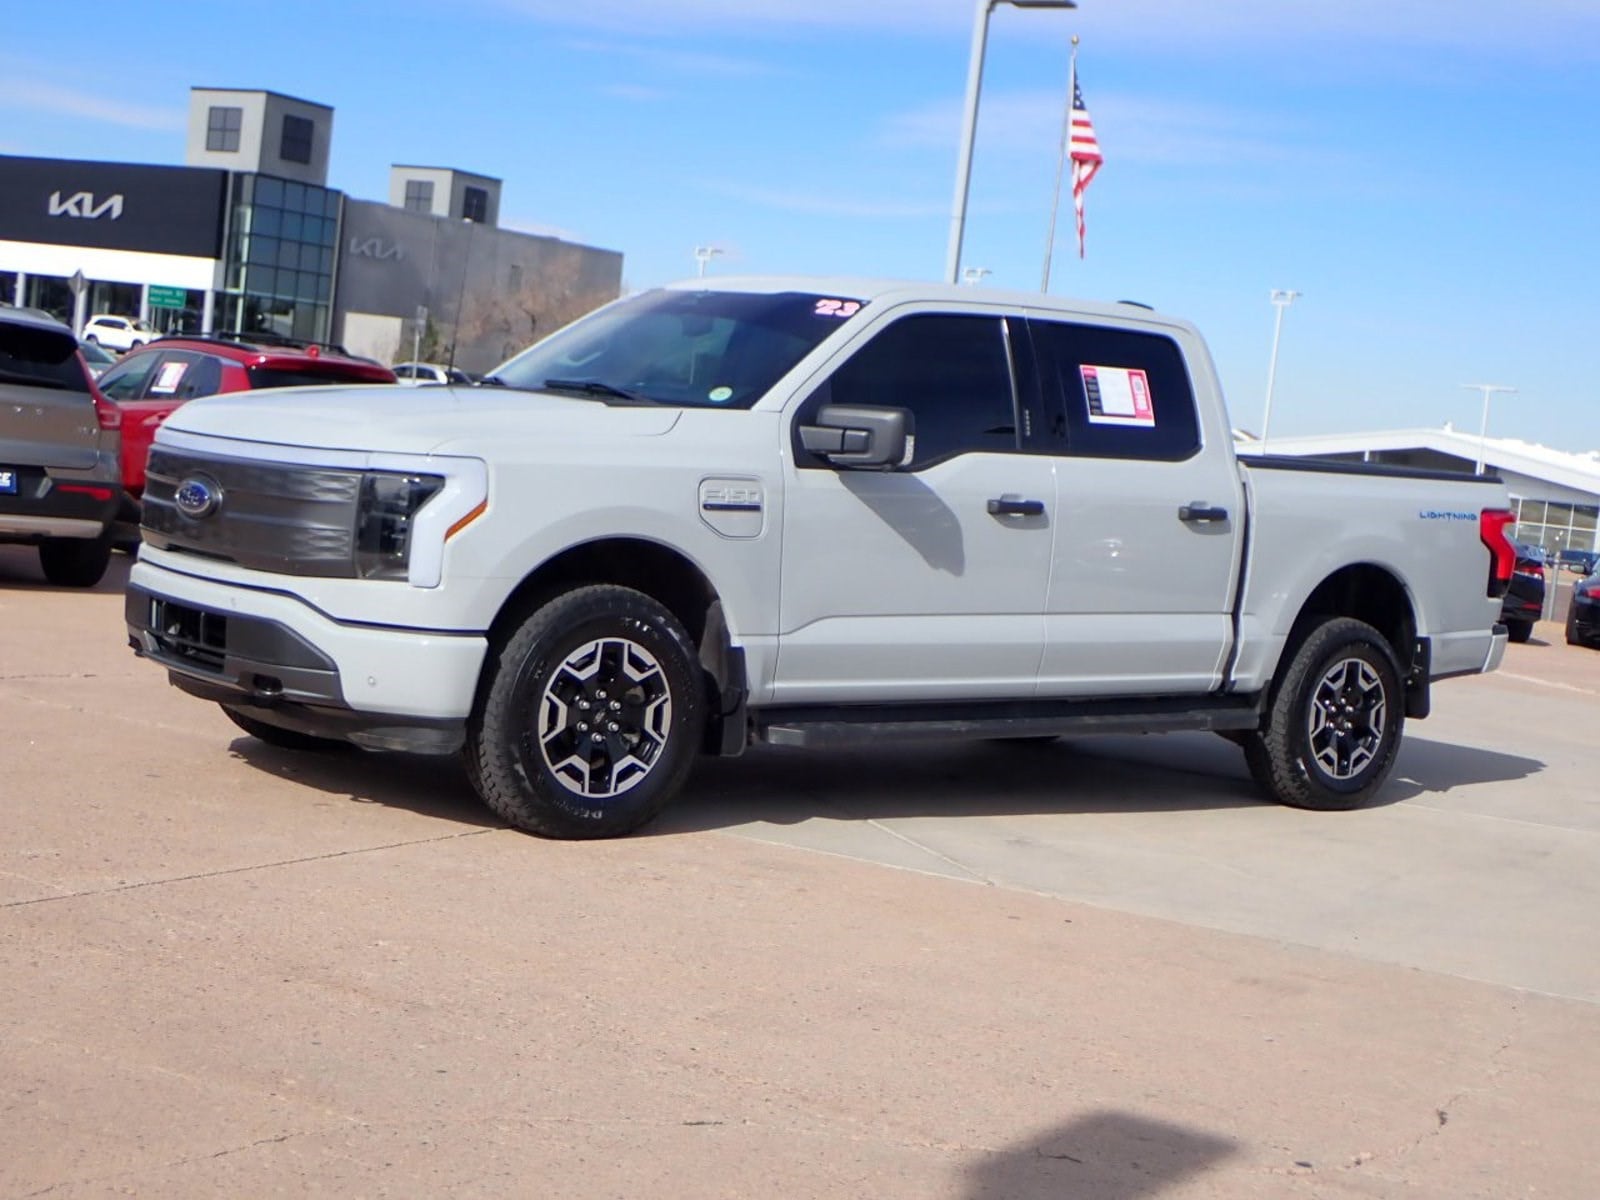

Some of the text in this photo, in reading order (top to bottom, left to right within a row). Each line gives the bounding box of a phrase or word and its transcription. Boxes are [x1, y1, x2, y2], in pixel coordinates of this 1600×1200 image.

[48, 190, 124, 220] KIA
[350, 237, 403, 260] KIA
[815, 299, 860, 317] 23
[1419, 511, 1477, 521] LIGHTNING
